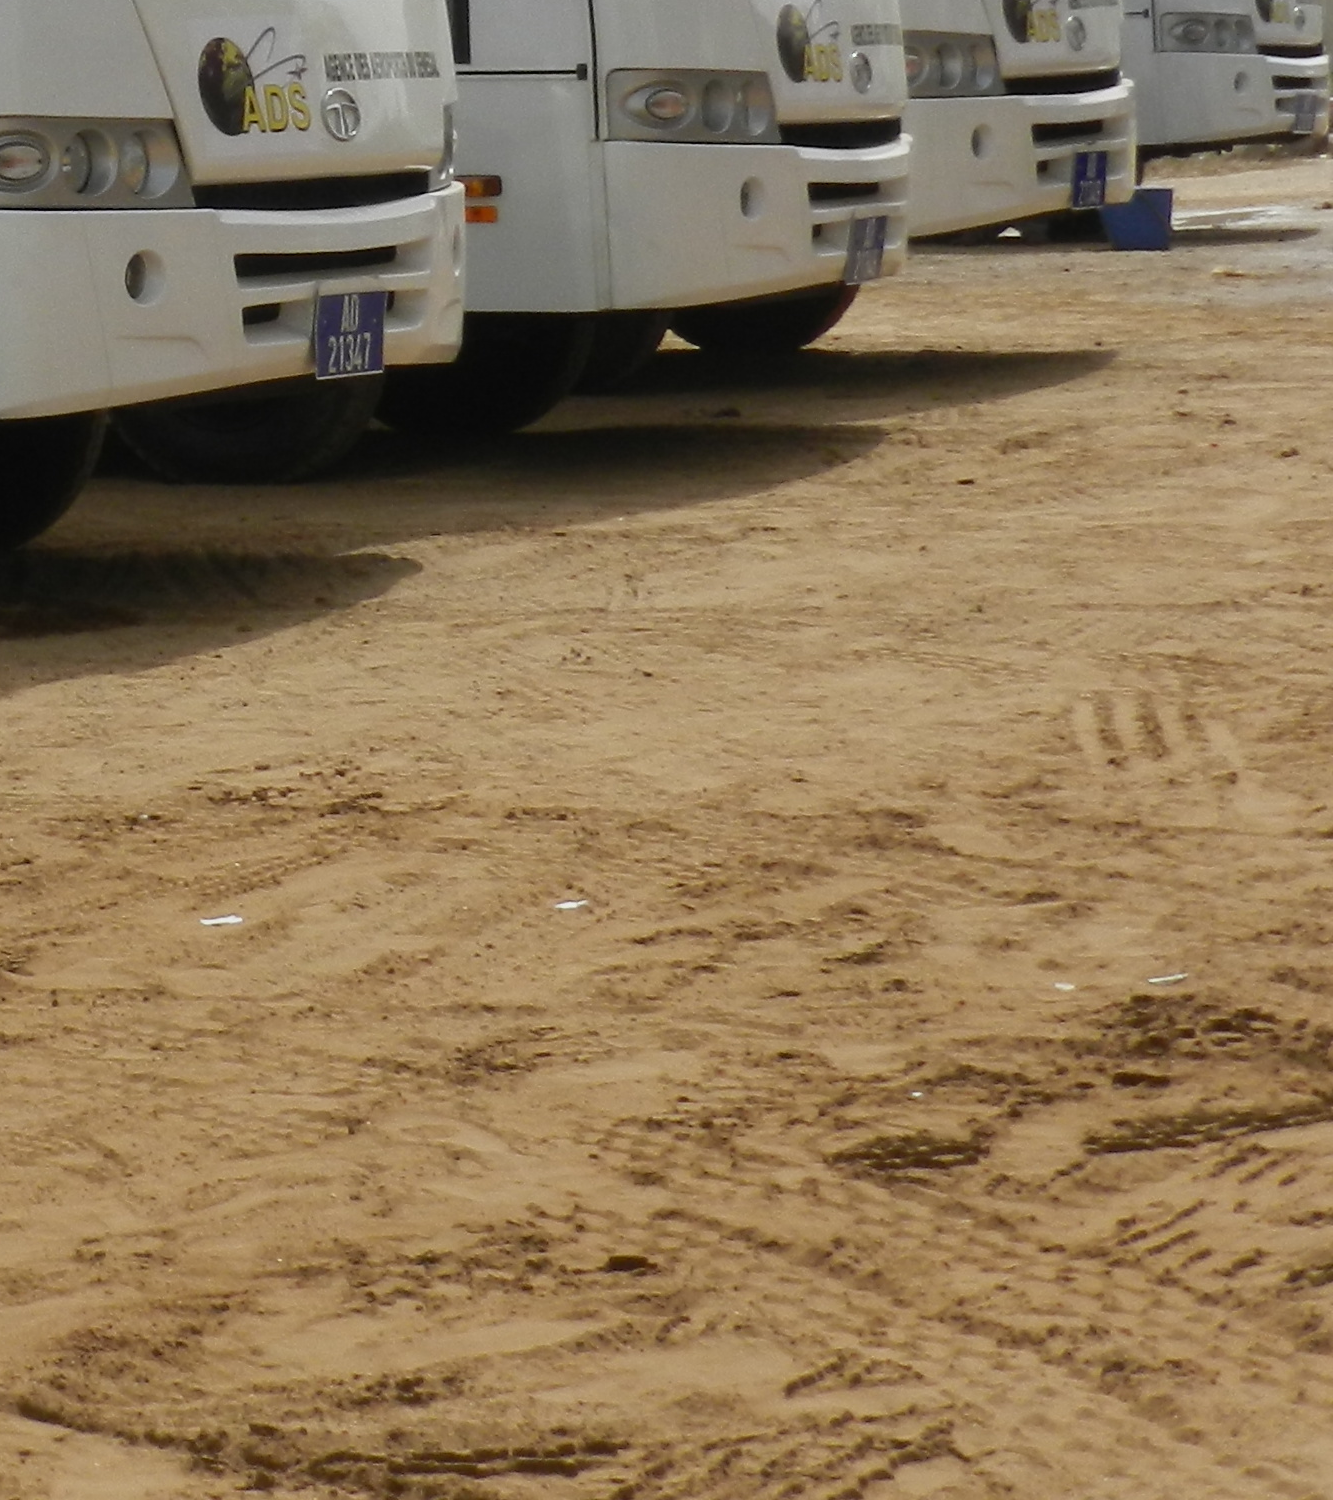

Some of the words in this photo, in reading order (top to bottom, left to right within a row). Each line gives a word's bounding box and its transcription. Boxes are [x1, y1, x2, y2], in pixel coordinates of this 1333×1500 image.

[241, 81, 312, 134] ADS
[340, 293, 360, 333] AD
[327, 331, 372, 374] 21347
